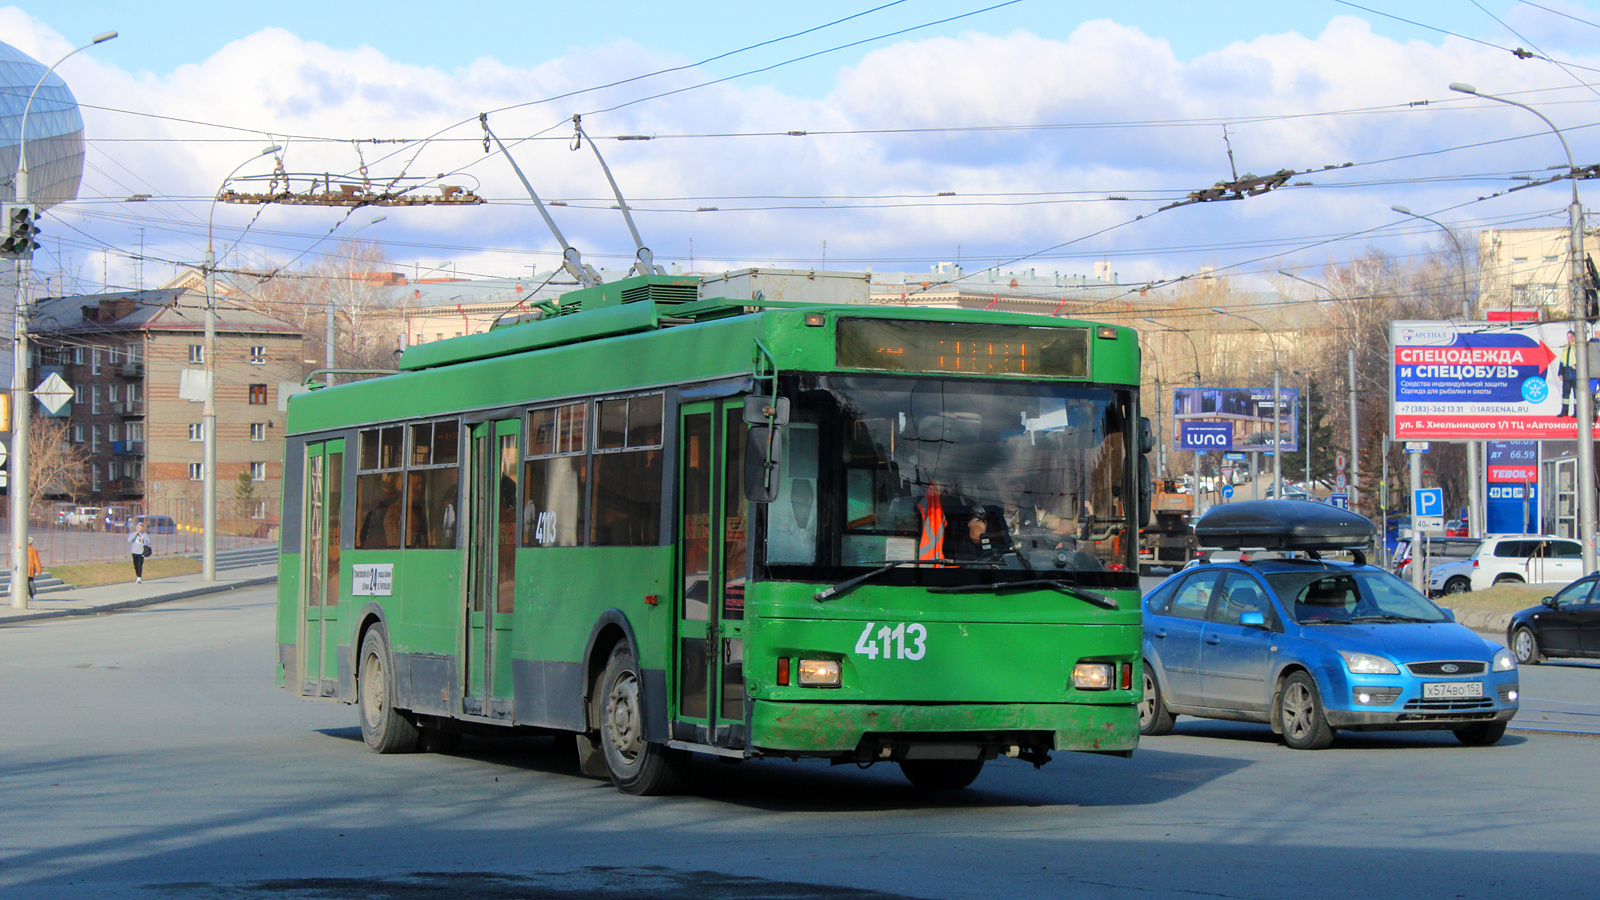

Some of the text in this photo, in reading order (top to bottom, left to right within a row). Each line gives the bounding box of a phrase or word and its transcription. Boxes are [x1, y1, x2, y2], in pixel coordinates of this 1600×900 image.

[1401, 350, 1524, 365] СПЕЦОДЕЖДА
[1401, 365, 1519, 380] и СПЕЦОБУВЬ
[1400, 380, 1431, 388] Средства
[1431, 380, 1483, 388] индивидуальной
[1400, 387, 1426, 395] Одежда
[1438, 387, 1466, 396] рыбалки
[1410, 405, 1446, 414] (383)-362
[1399, 421, 1413, 430] ул.
[1415, 420, 1425, 429] Б.
[1426, 421, 1496, 430] Хмельницкого
[1497, 420, 1509, 430] 1/1
[1510, 421, 1525, 430] ТЦ
[1510, 450, 1535, 459] 66.59
[535, 511, 557, 544] 4113
[369, 568, 378, 591] 24
[854, 622, 928, 661] 4113
[1465, 683, 1480, 693] 152
